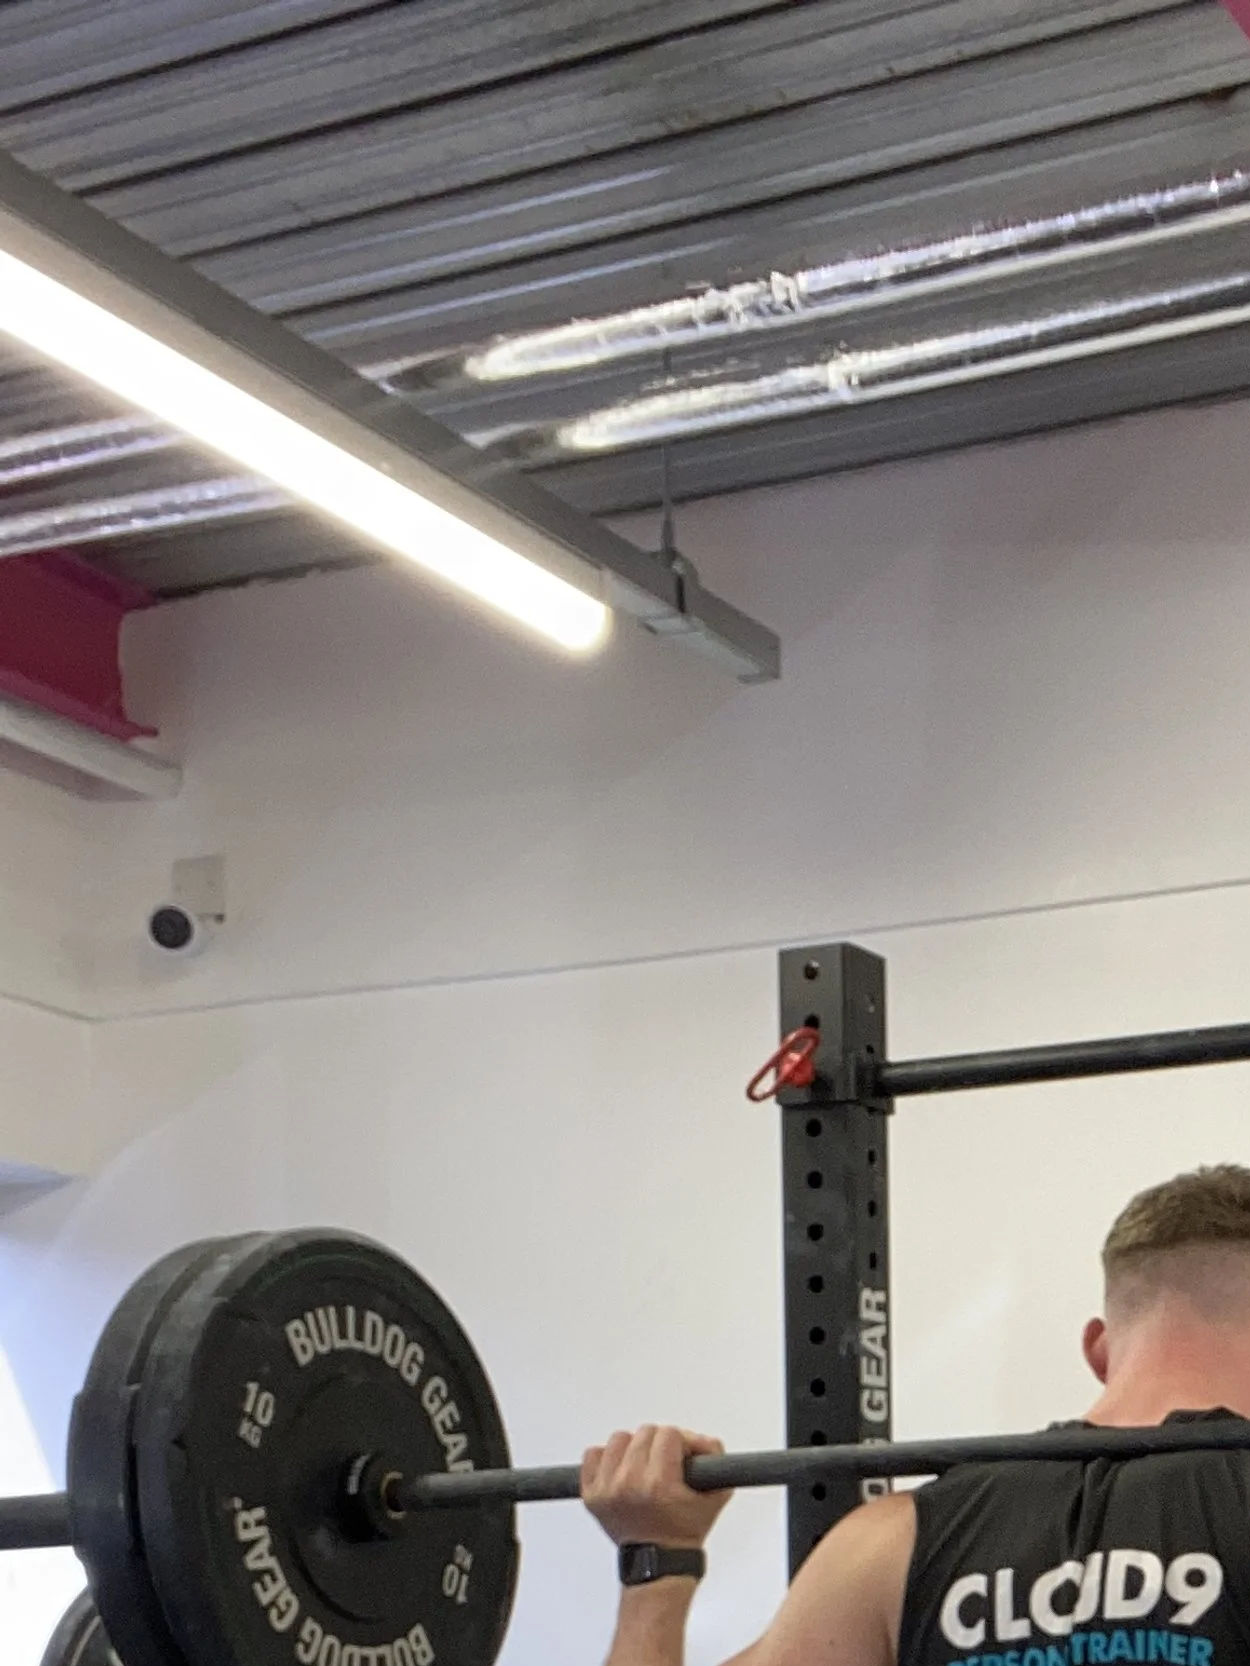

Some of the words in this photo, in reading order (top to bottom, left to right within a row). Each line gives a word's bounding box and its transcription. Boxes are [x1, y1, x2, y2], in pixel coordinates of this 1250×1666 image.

[286, 1305, 425, 1385] BULLDOG
[859, 1286, 888, 1423] GEAR
[244, 1381, 276, 1428] 10
[233, 1505, 299, 1633] GEAR
